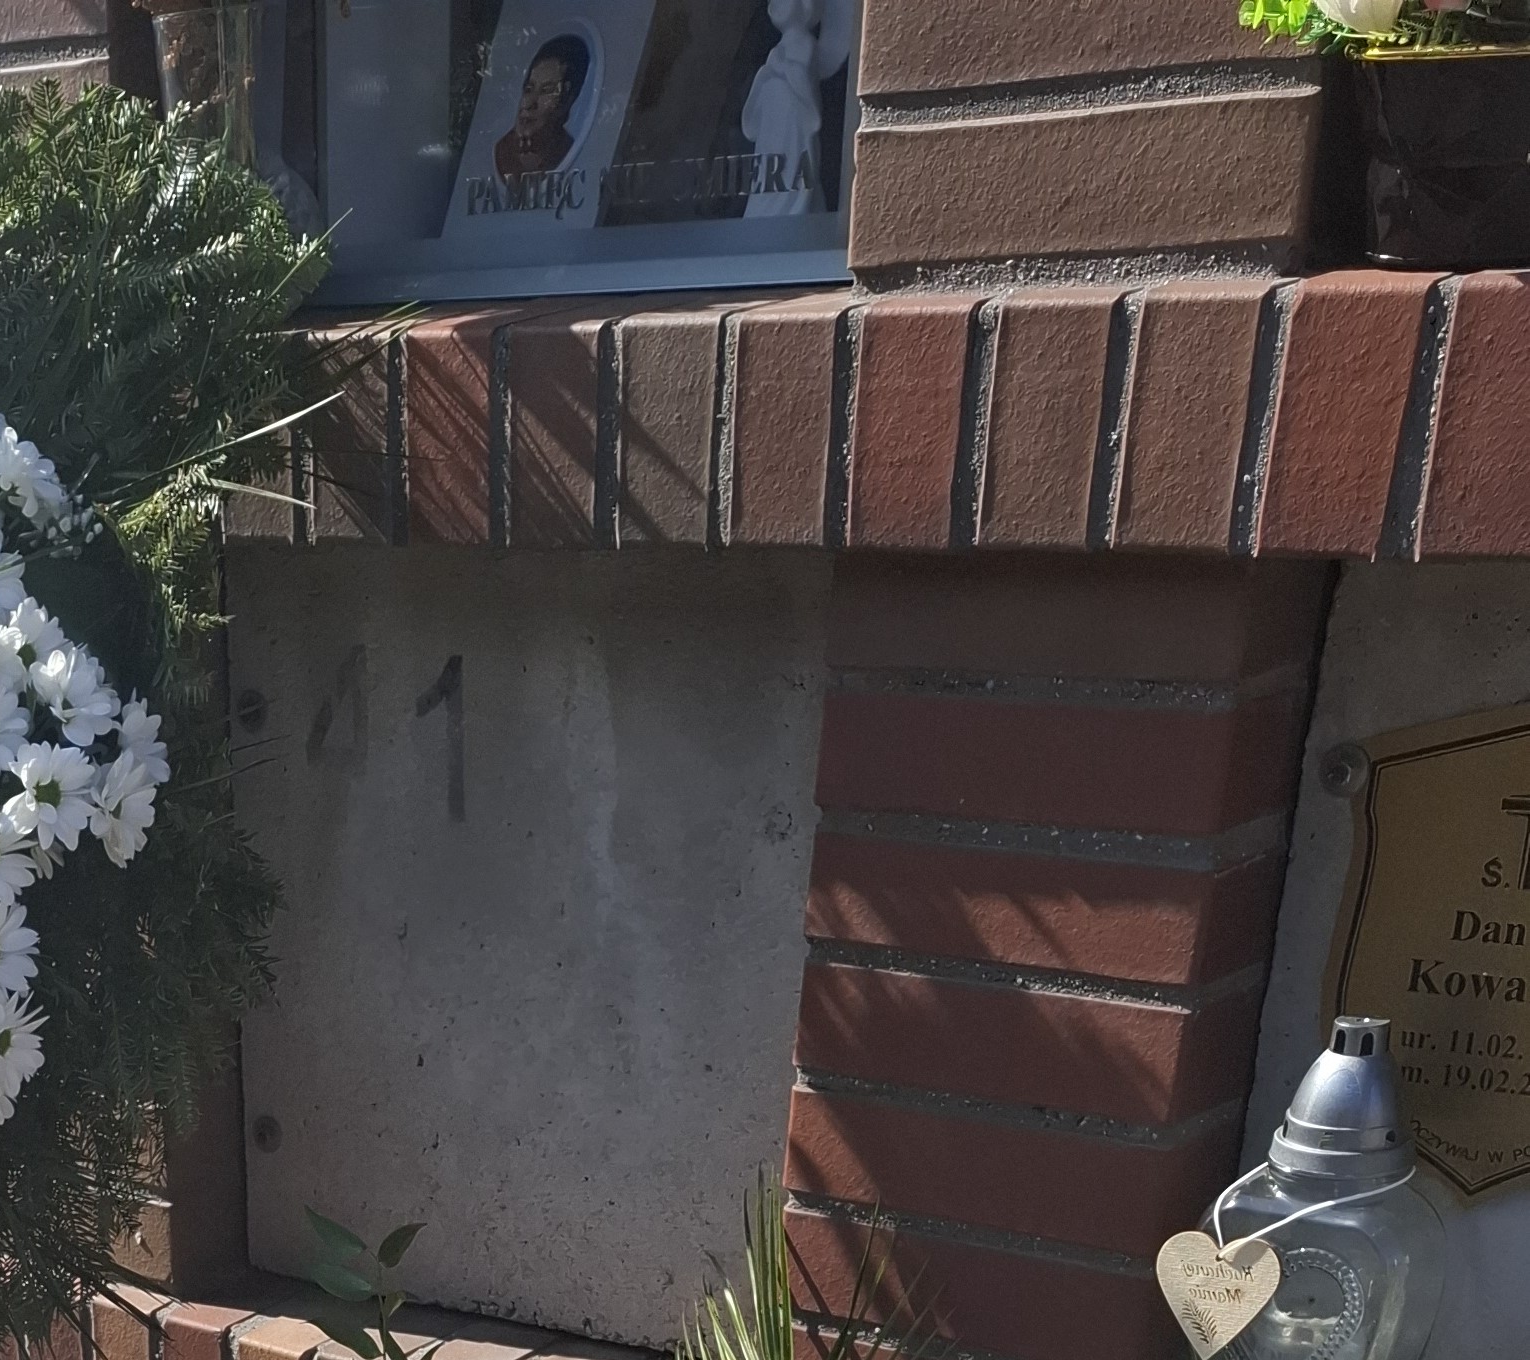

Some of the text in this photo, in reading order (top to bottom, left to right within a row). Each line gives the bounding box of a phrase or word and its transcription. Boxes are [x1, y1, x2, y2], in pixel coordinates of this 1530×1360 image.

[1449, 908, 1528, 948] Dan
[1406, 957, 1528, 1004] Kowa
[1400, 1028, 1525, 1061] ur. 11.02.
[1487, 1149, 1504, 1165] W
